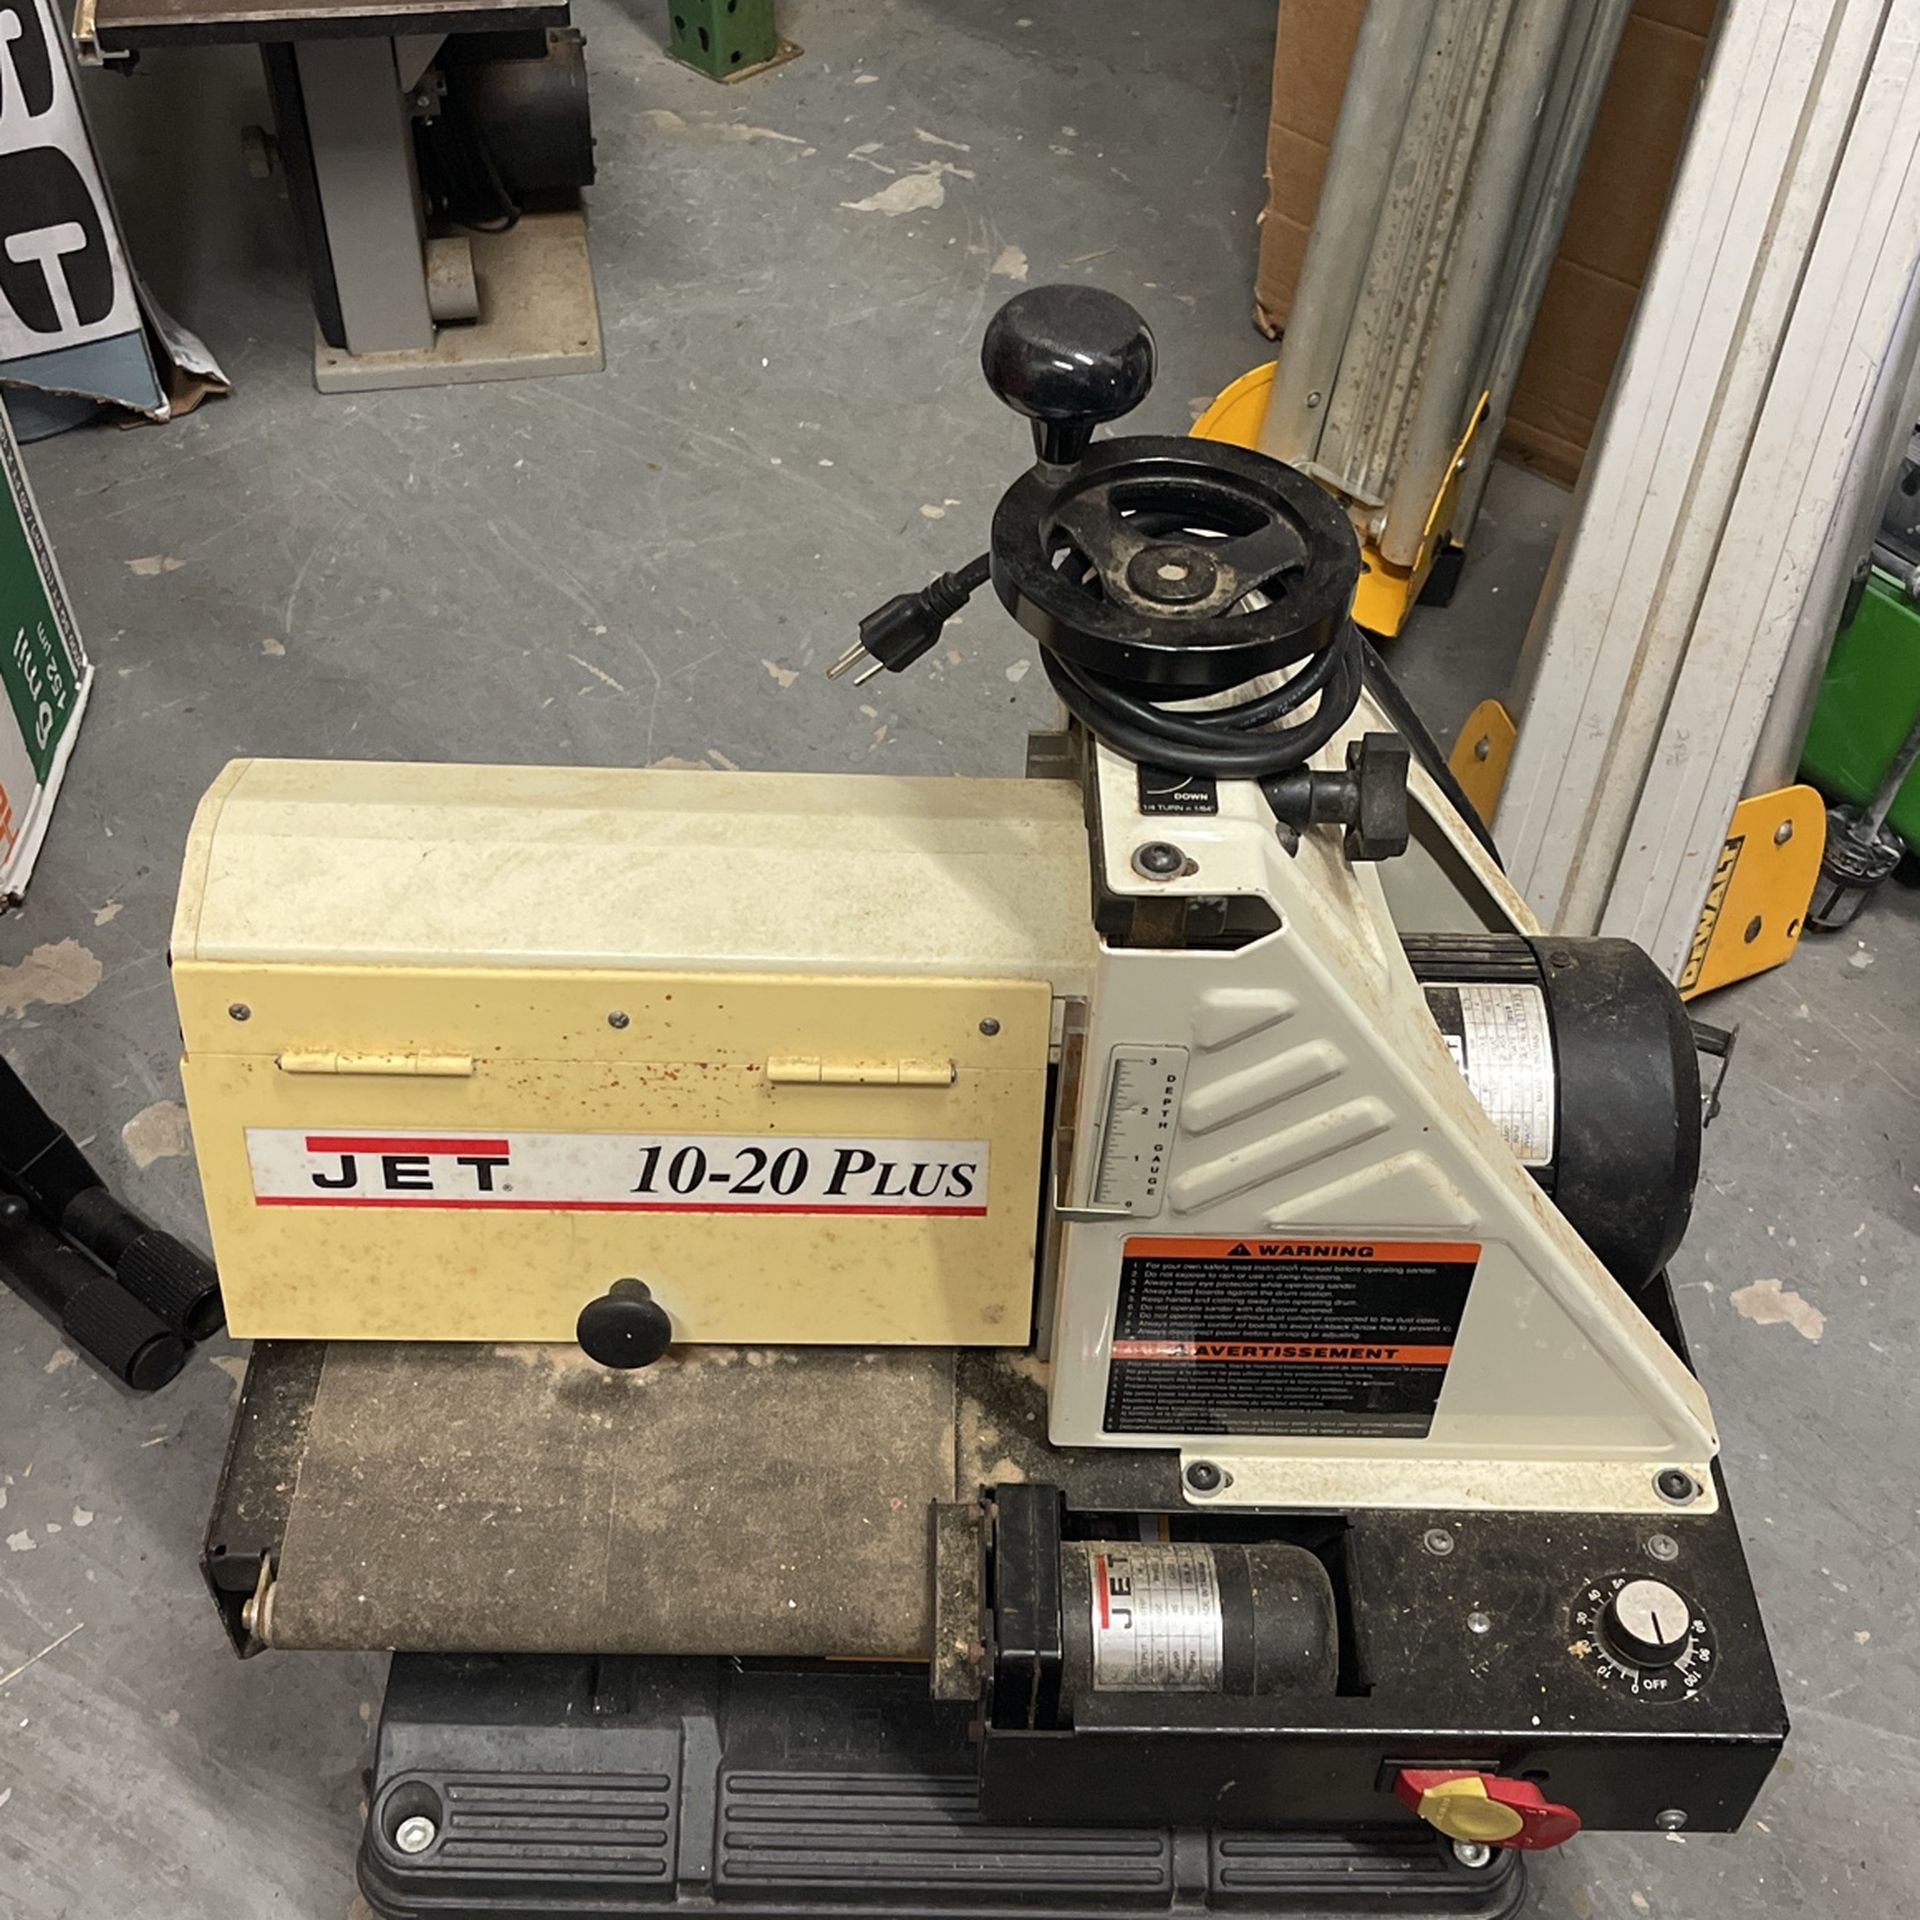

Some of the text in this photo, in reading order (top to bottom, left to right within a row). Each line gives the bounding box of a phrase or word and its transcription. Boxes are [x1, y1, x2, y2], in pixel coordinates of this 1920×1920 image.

[13, 626, 53, 750] 6 mil
[46, 666, 67, 710] 152
[1174, 792, 1208, 801] DOWN
[1149, 1057, 1158, 1066] 3
[1140, 1107, 1149, 1115] 2
[1146, 1074, 1176, 1196] DEPTH GAUGE
[312, 1145, 978, 1199] JET 10-20 PLUS
[1258, 1244, 1374, 1258] WARNING
[1194, 1346, 1400, 1360] AVERTISSEMENT
[1108, 1553, 1132, 1629] JET
[1631, 1684, 1639, 1694] 0
[1643, 1679, 1668, 1689] OFF
